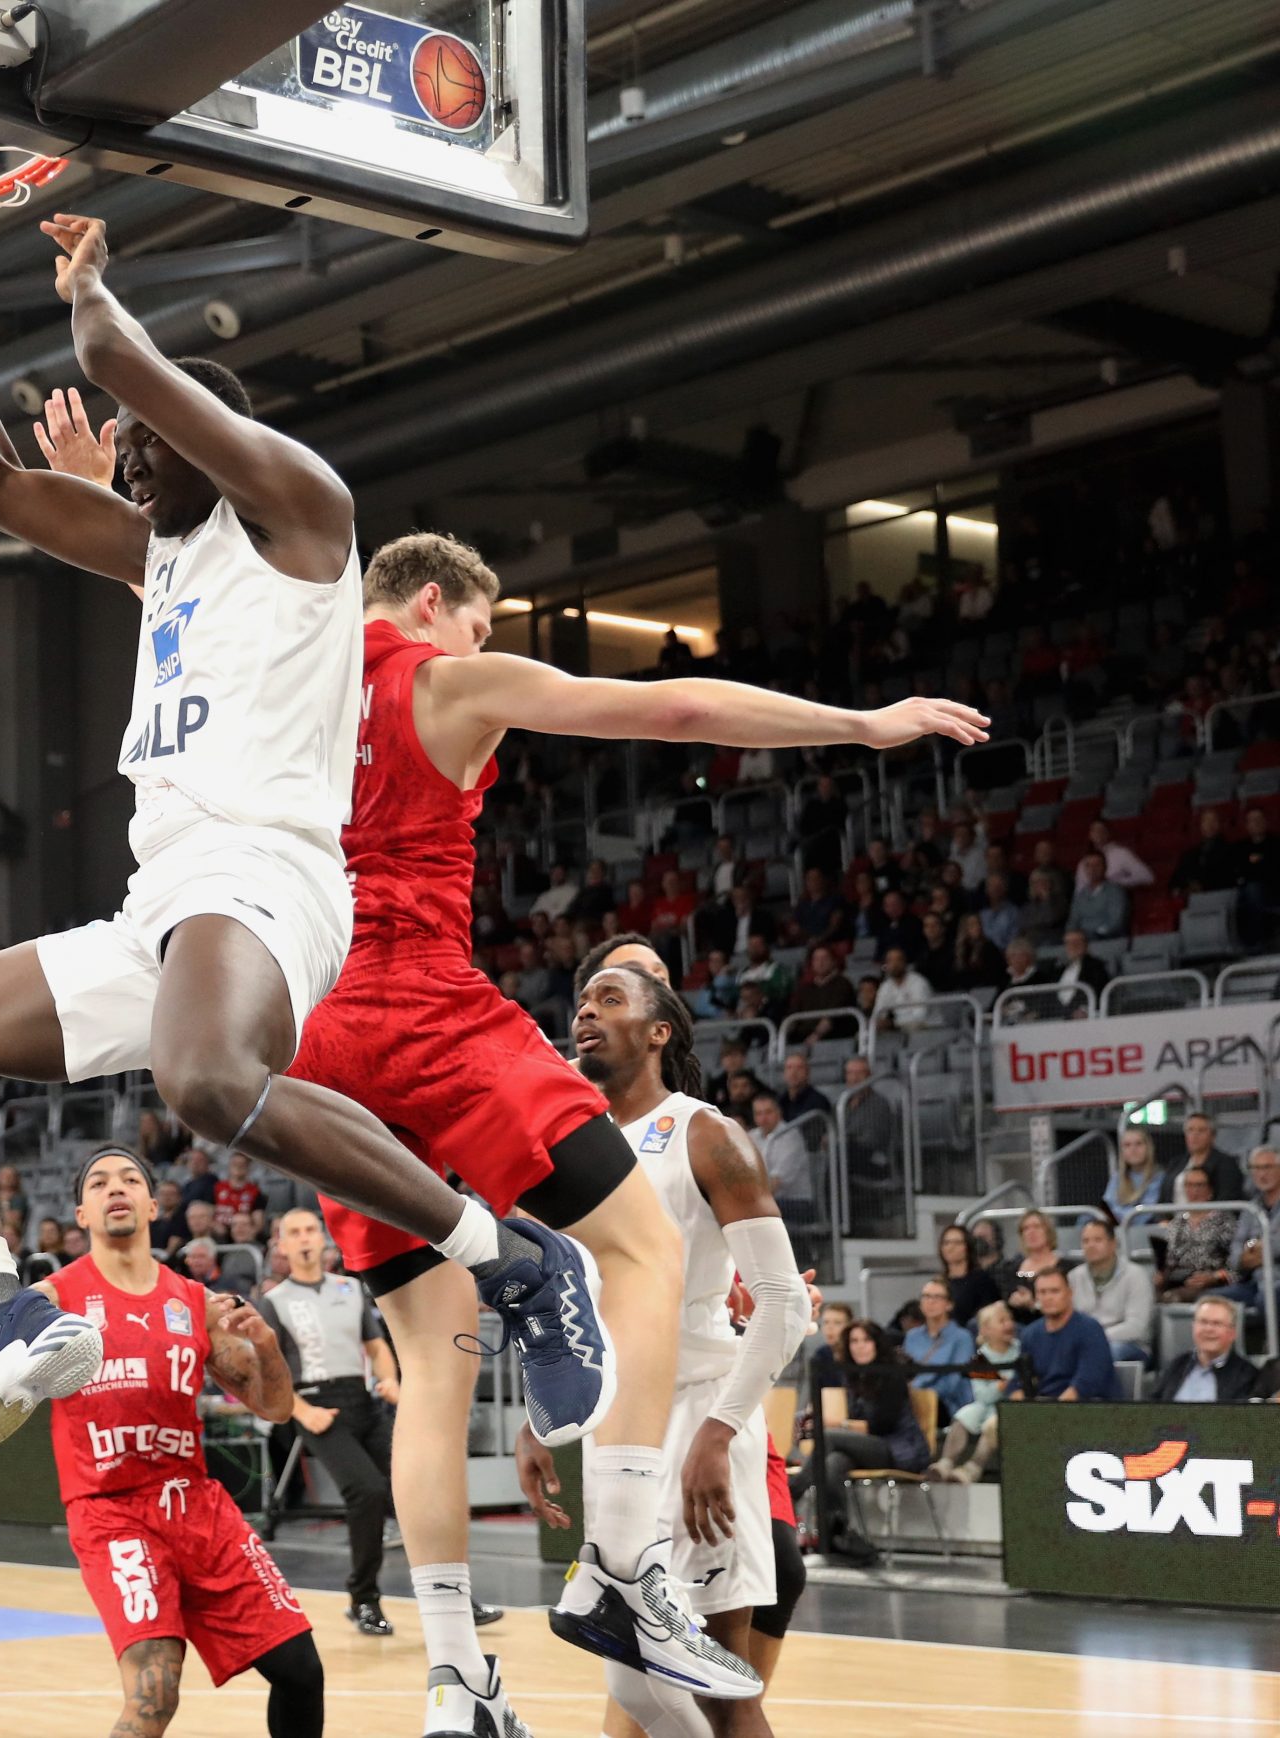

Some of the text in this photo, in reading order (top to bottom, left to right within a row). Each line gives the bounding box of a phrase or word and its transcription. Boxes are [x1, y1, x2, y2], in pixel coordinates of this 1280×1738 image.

[312, 47, 393, 103] BBL
[157, 654, 181, 686] SNP
[1008, 1041, 1144, 1084] brose
[166, 1344, 197, 1396] 12
[86, 1421, 195, 1458] brose
[240, 1543, 283, 1611] AUTOMATION
